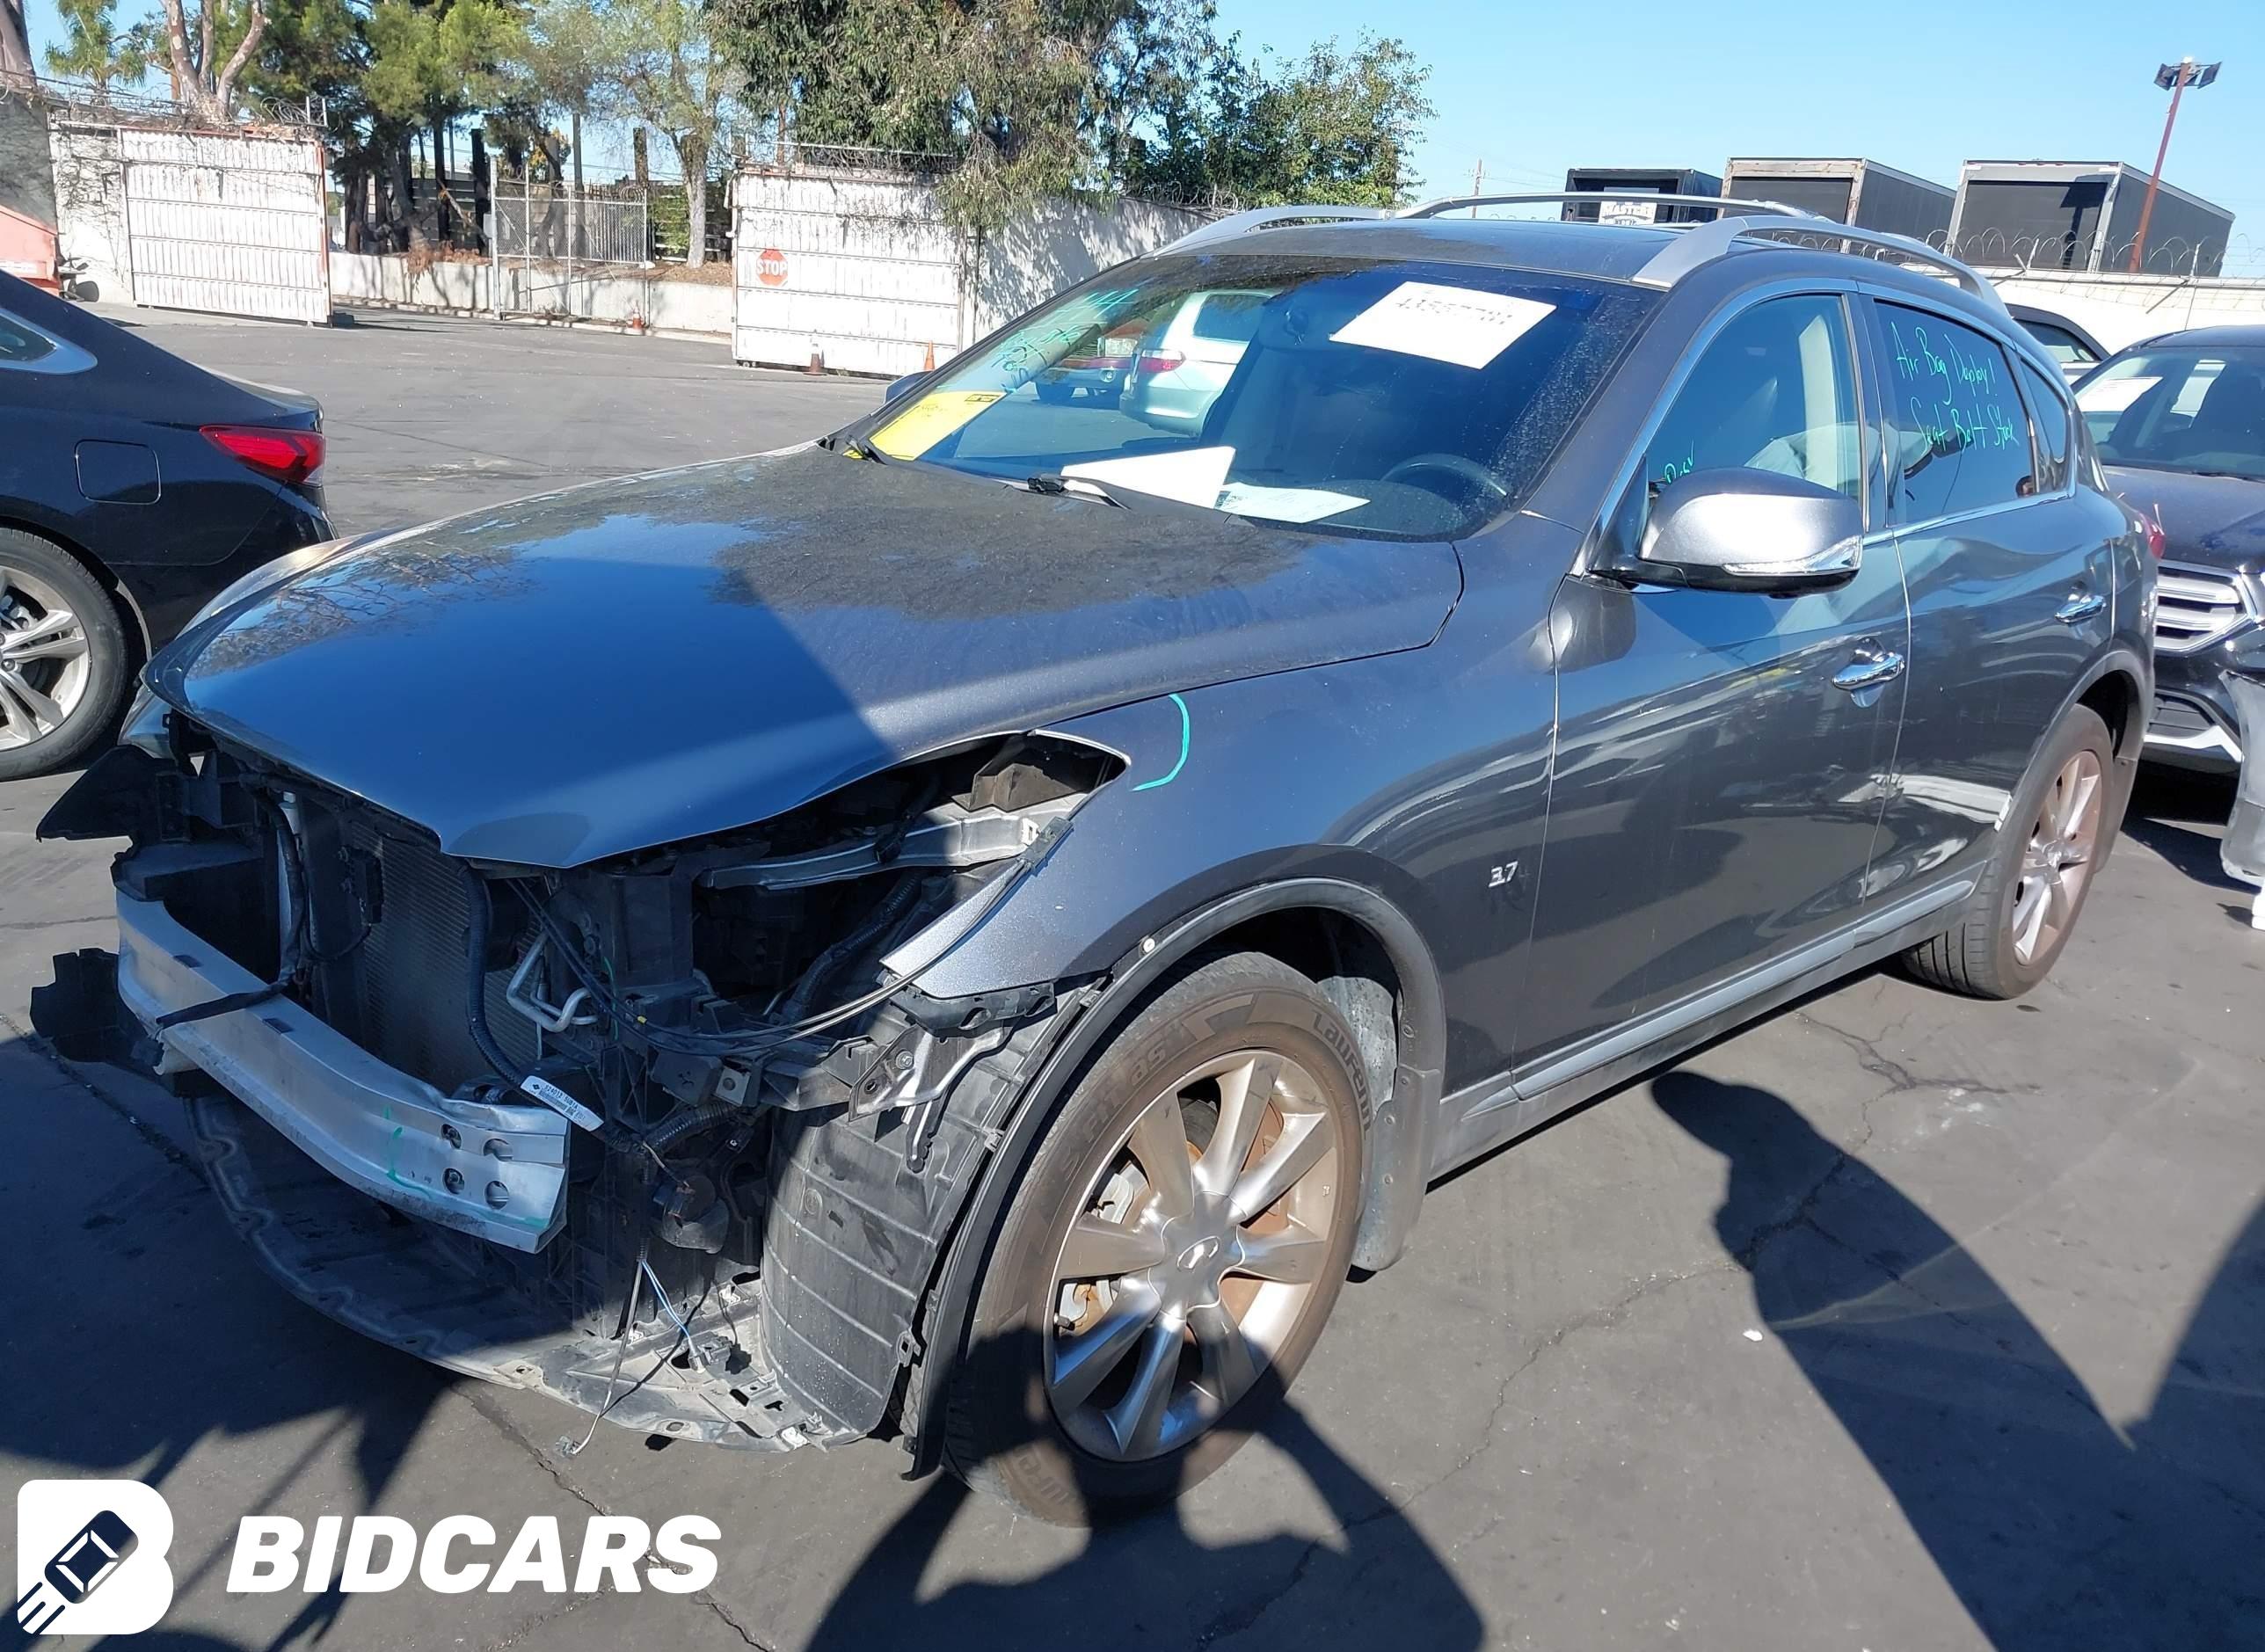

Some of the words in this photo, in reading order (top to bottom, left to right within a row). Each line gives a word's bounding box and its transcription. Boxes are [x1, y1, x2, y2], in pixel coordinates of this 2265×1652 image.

[756, 258, 788, 275] STOP
[1890, 321, 1919, 381] Air
[1915, 326, 1952, 405] Bag
[1910, 397, 1948, 455] Seat
[1950, 403, 1988, 453] Belt
[1488, 861, 1518, 888] 3.7
